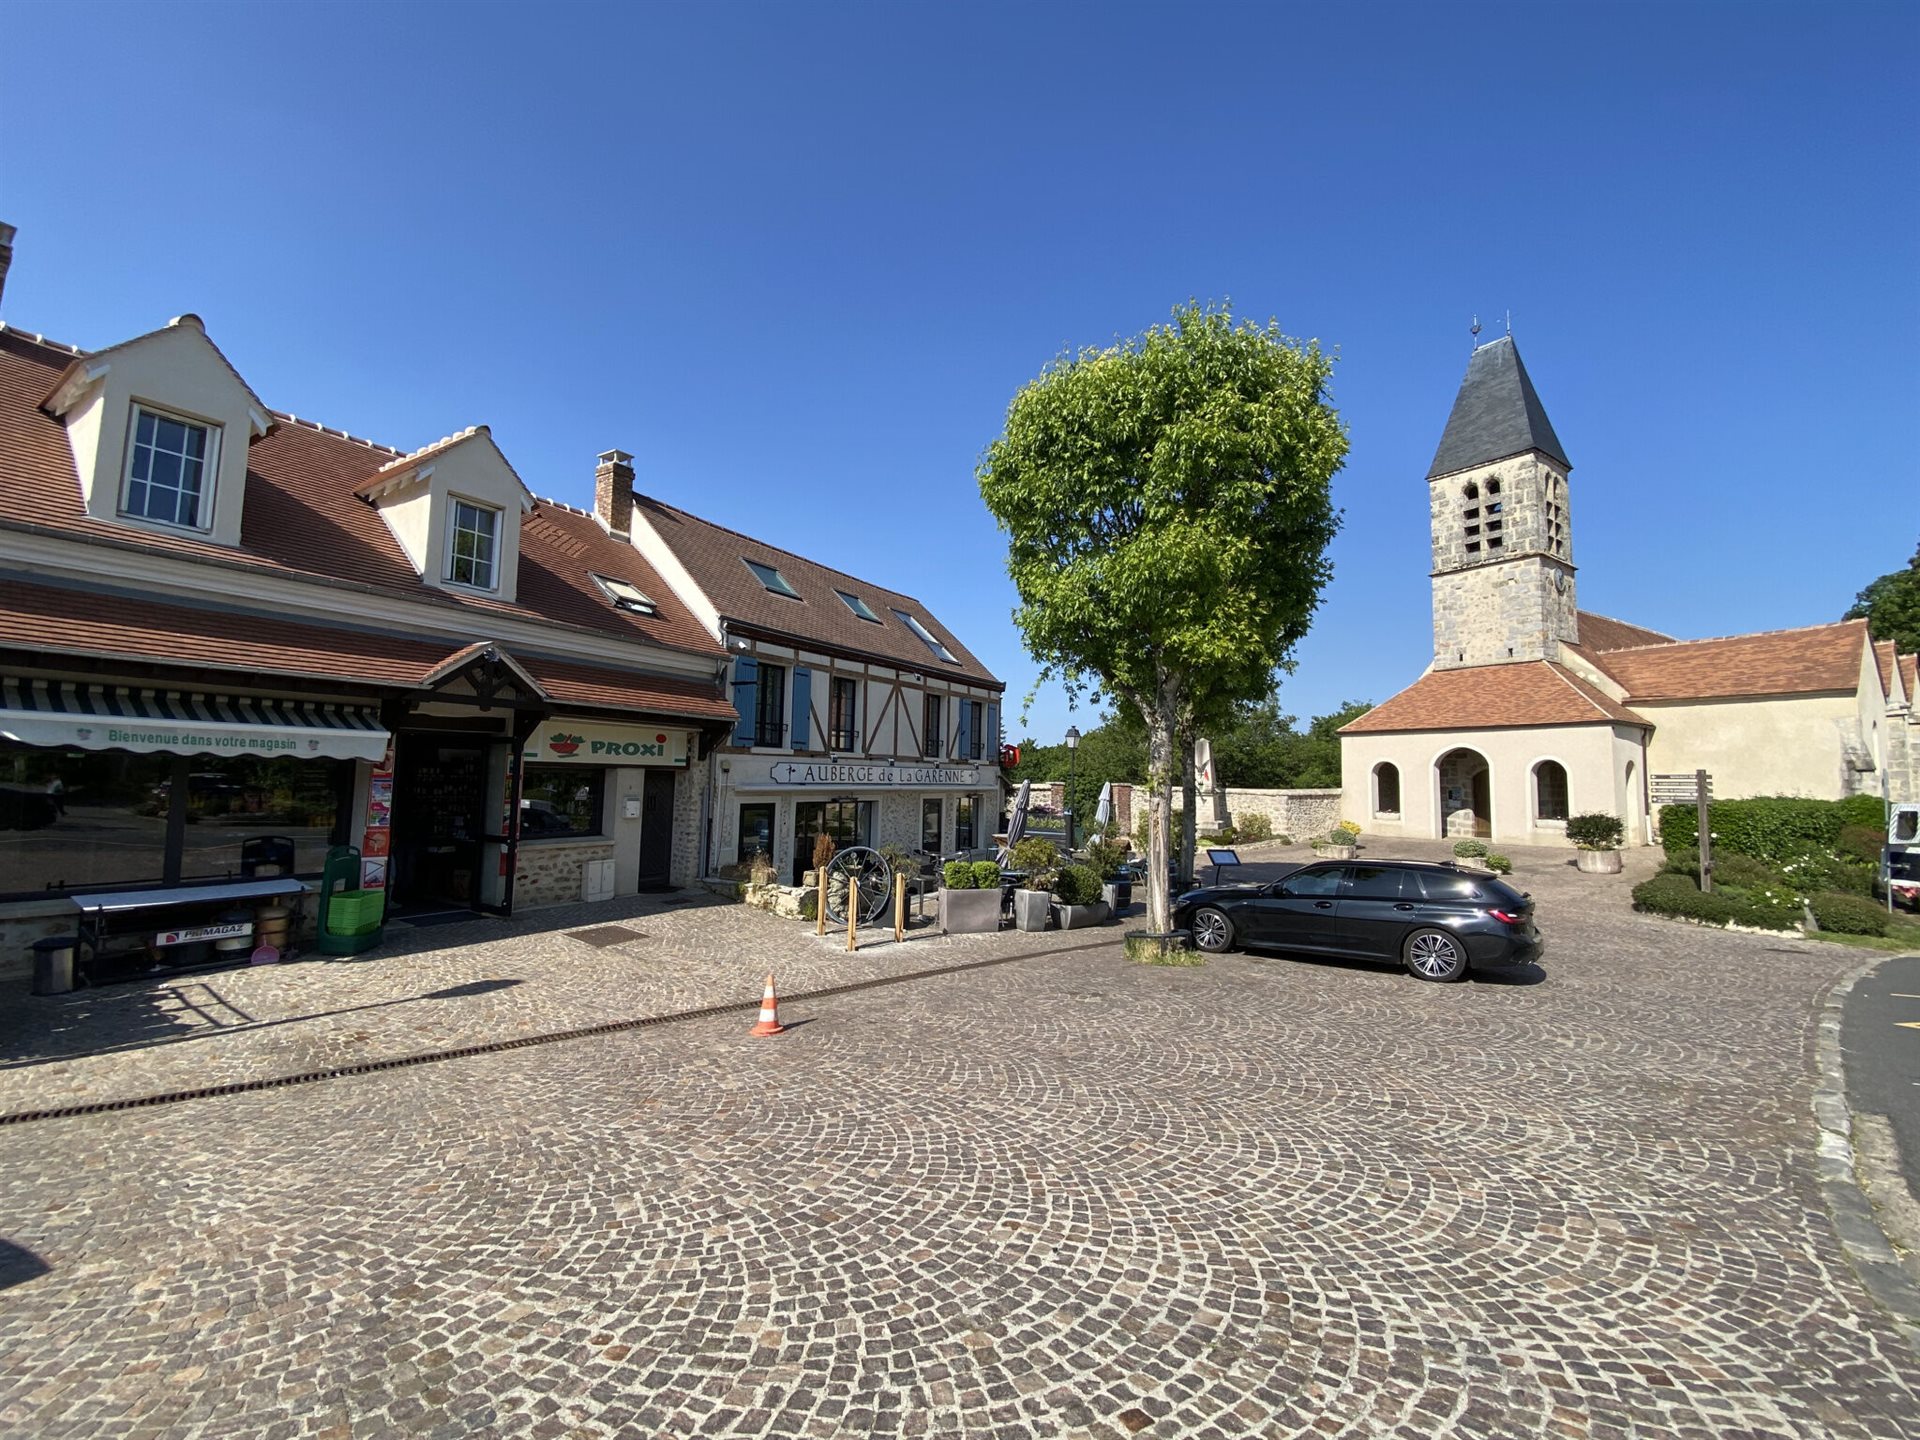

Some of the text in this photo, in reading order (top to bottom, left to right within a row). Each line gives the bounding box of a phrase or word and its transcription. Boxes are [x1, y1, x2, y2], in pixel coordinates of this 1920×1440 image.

[108, 729, 297, 751] Bienvenue dans votre magasin
[804, 765, 874, 782] AUBERGE
[878, 768, 894, 782] de
[915, 769, 965, 783] GARENNE
[184, 923, 244, 938] PRIMAGAZ
